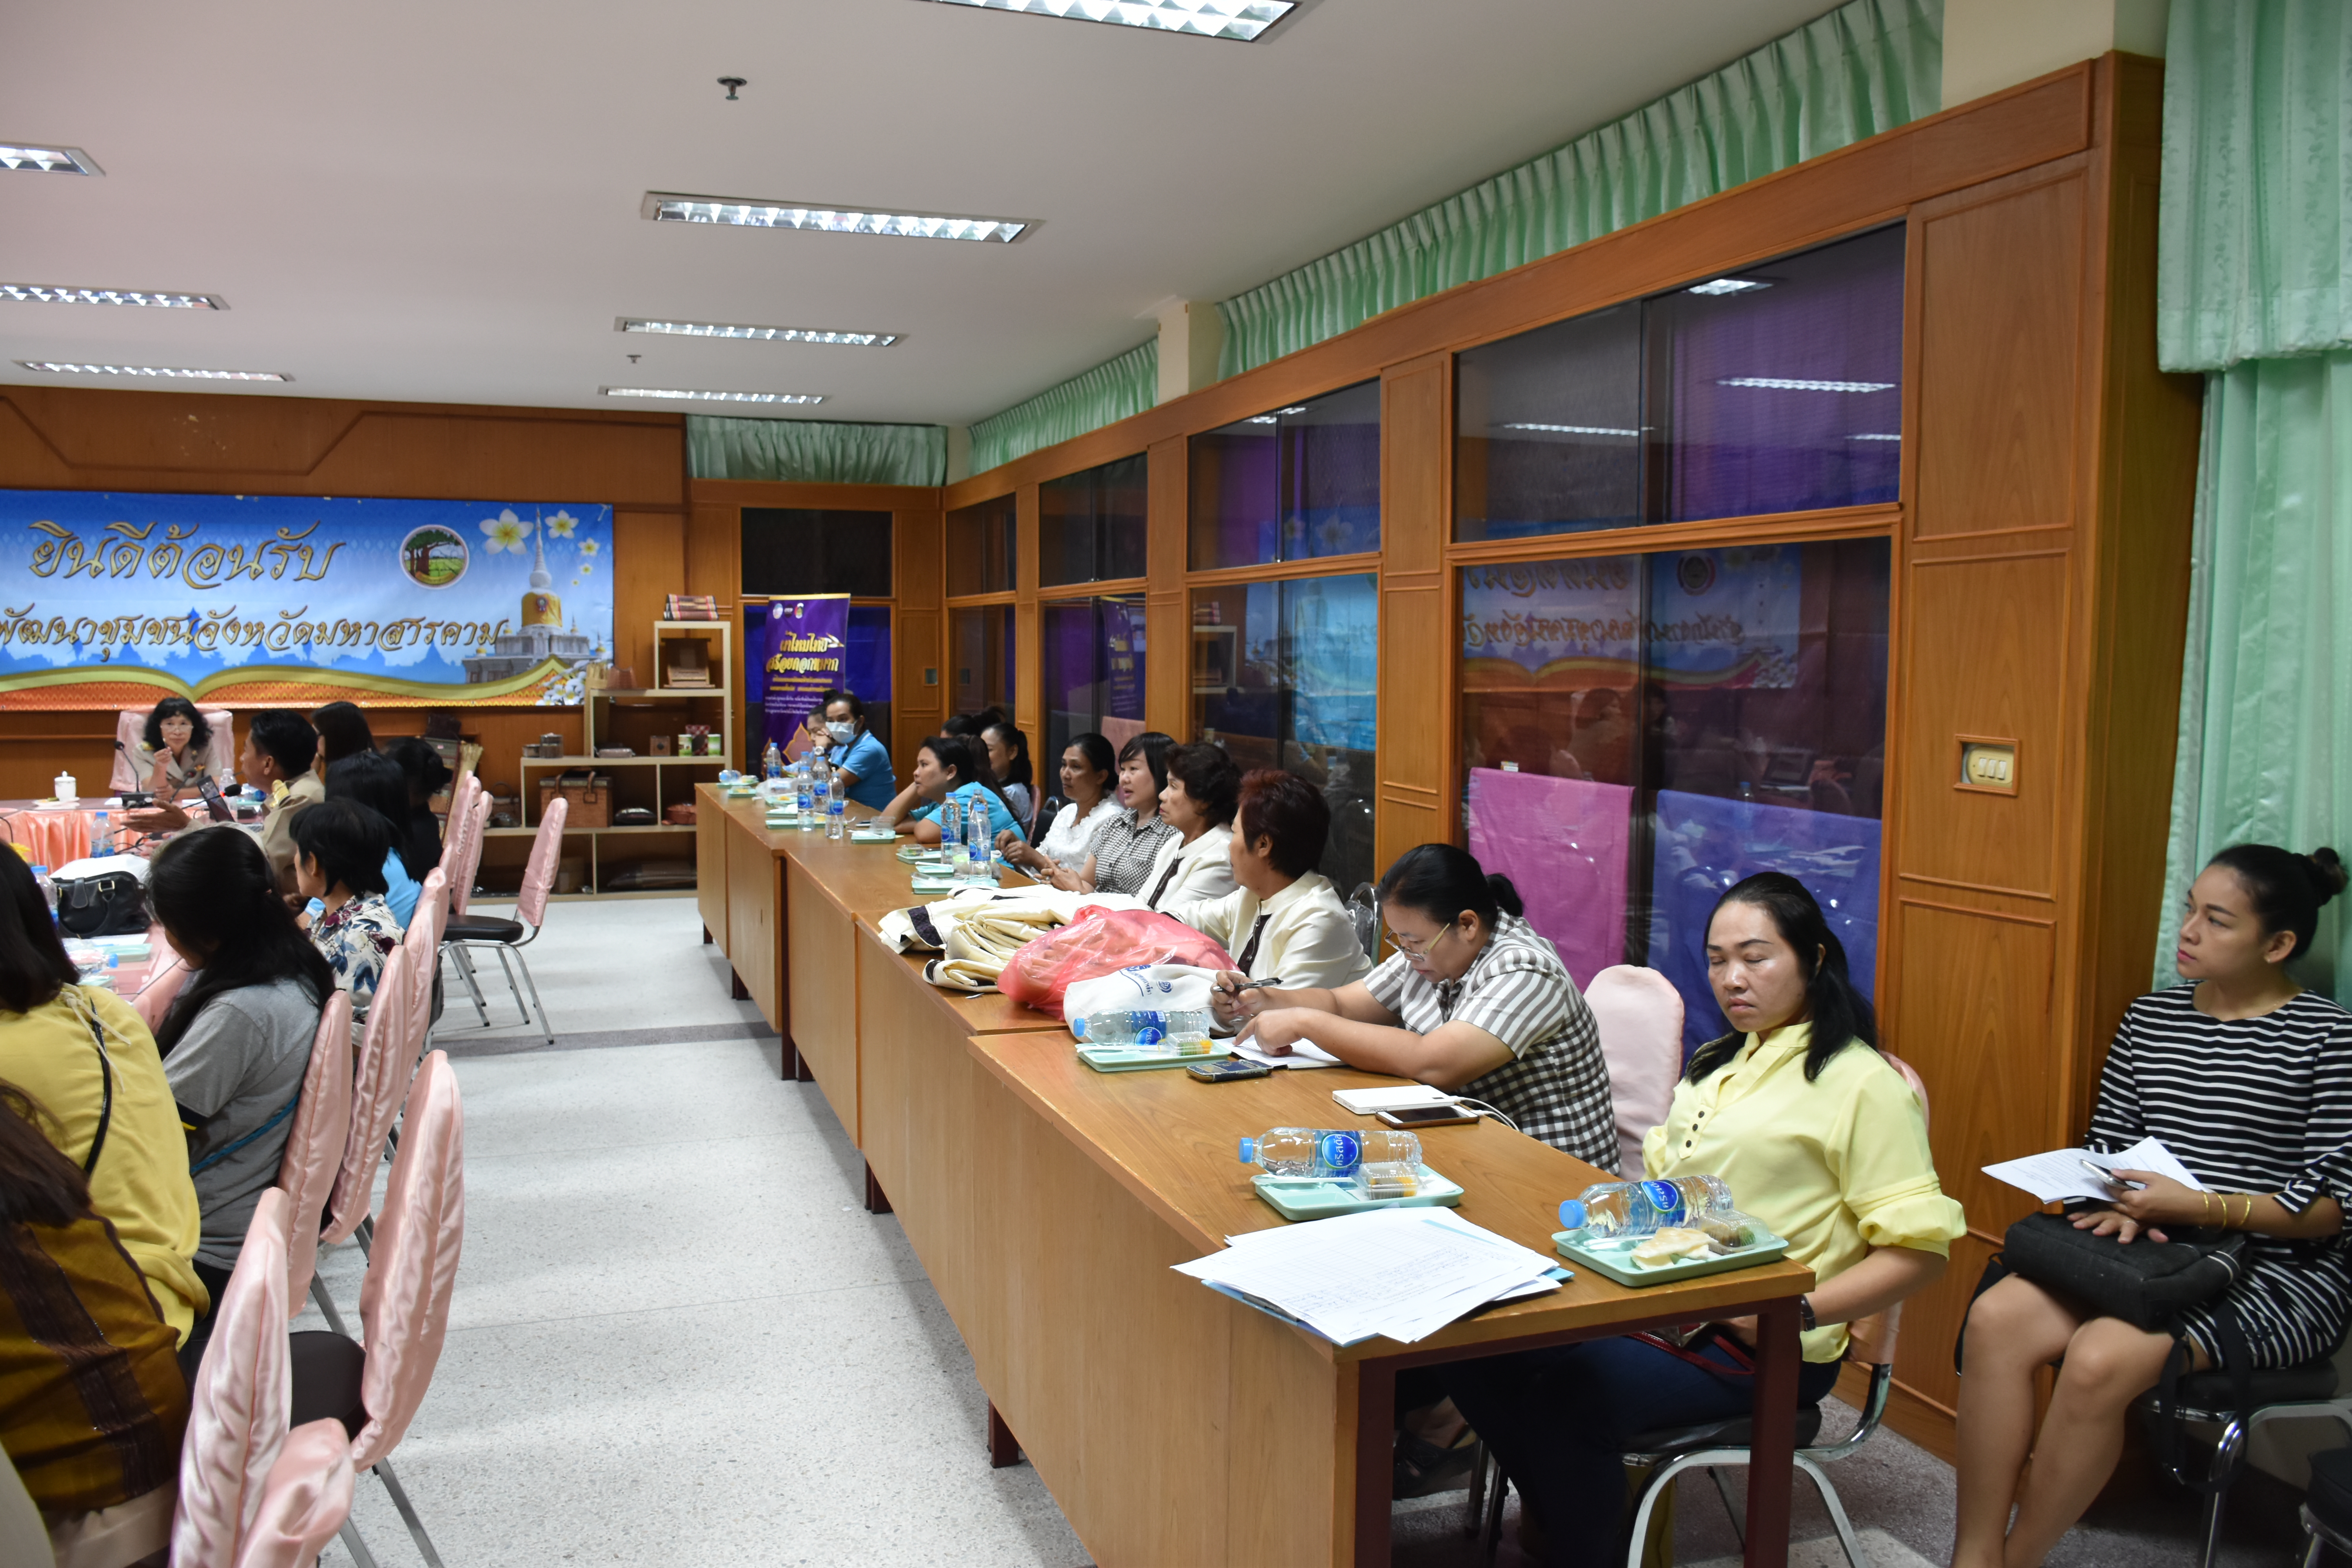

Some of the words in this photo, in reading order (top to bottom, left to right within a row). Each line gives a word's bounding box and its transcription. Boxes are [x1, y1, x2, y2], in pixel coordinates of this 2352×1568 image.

[28, 520, 347, 590] ยินดีต้อนรับ
[1144, 1028, 1152, 1045] YSTAL
